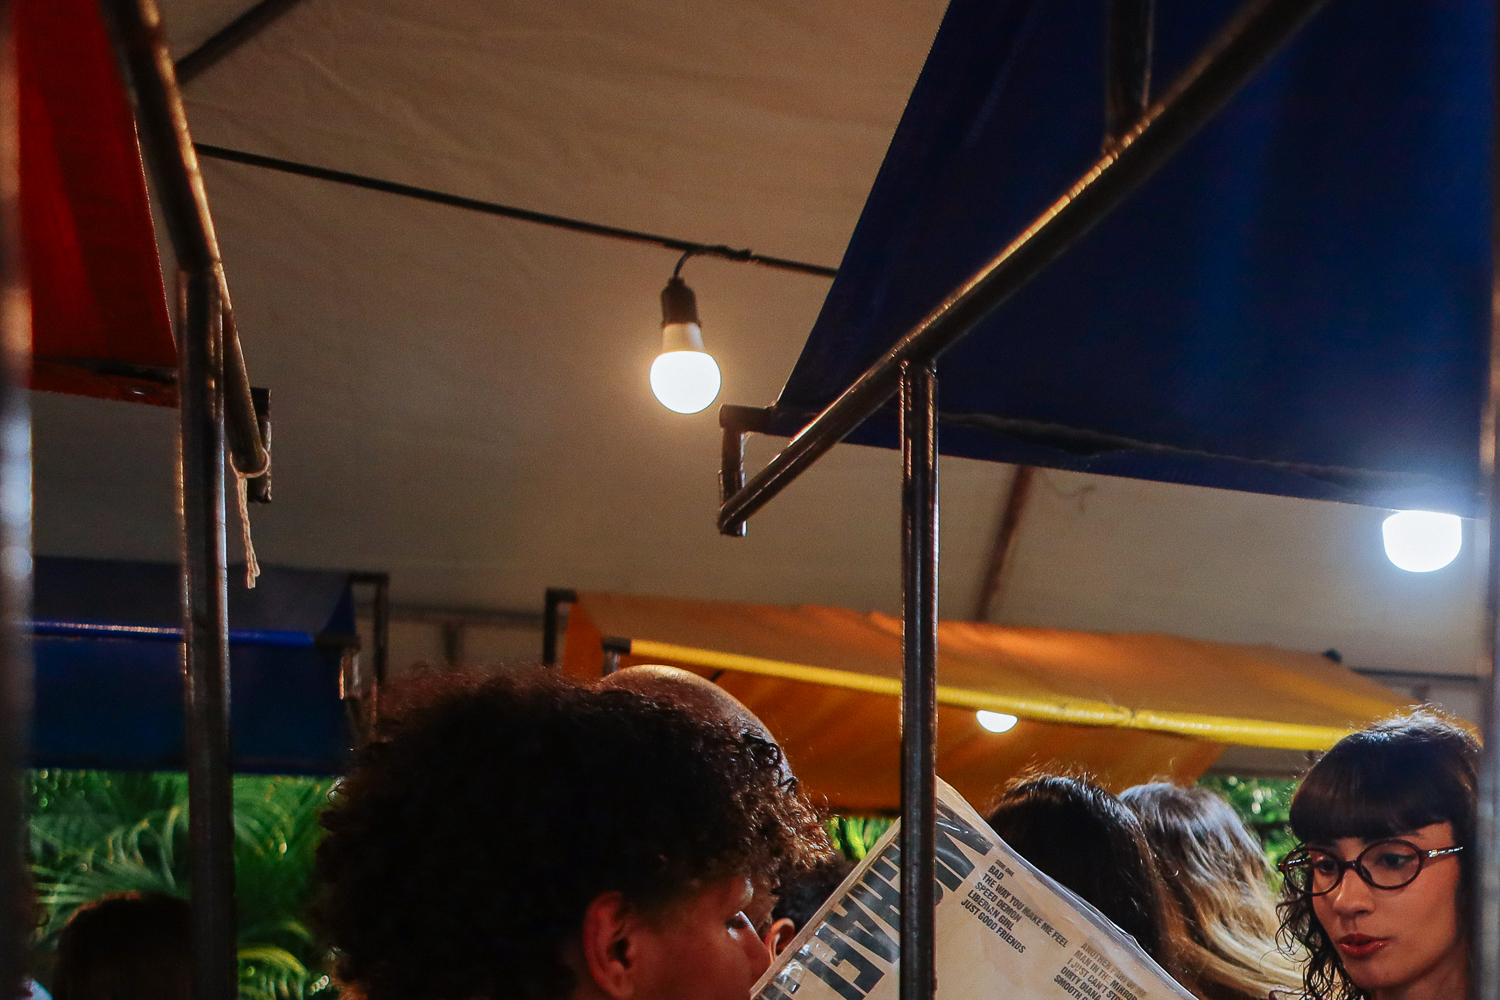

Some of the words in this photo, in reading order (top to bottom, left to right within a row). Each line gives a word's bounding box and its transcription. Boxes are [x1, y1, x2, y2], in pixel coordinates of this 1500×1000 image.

[988, 865, 1004, 880] BAD
[967, 890, 1000, 918] LIBERIAN
[998, 913, 1016, 931] GIRL
[975, 881, 998, 903] SPEED
[996, 899, 1022, 923] DEMON
[982, 873, 996, 888] THE
[995, 884, 1011, 900] WAY
[1009, 895, 1025, 910] YOU
[1022, 906, 1041, 927] MAKE
[1041, 922, 1054, 935] ME
[1052, 931, 1069, 948] FEEL
[961, 899, 980, 915] JUST
[977, 911, 998, 930] GOOD
[996, 926, 1026, 953] FRIENDS
[1073, 950, 1091, 967] MAN
[1089, 962, 1101, 975] IN
[1098, 969, 1113, 983] THE
[1081, 943, 1110, 970] ANOTHER
[1054, 974, 1083, 1000] SMOOTH
[1060, 966, 1082, 985] DIRTY
[1071, 961, 1089, 978] JUST
[1087, 974, 1108, 994] CAN'T
